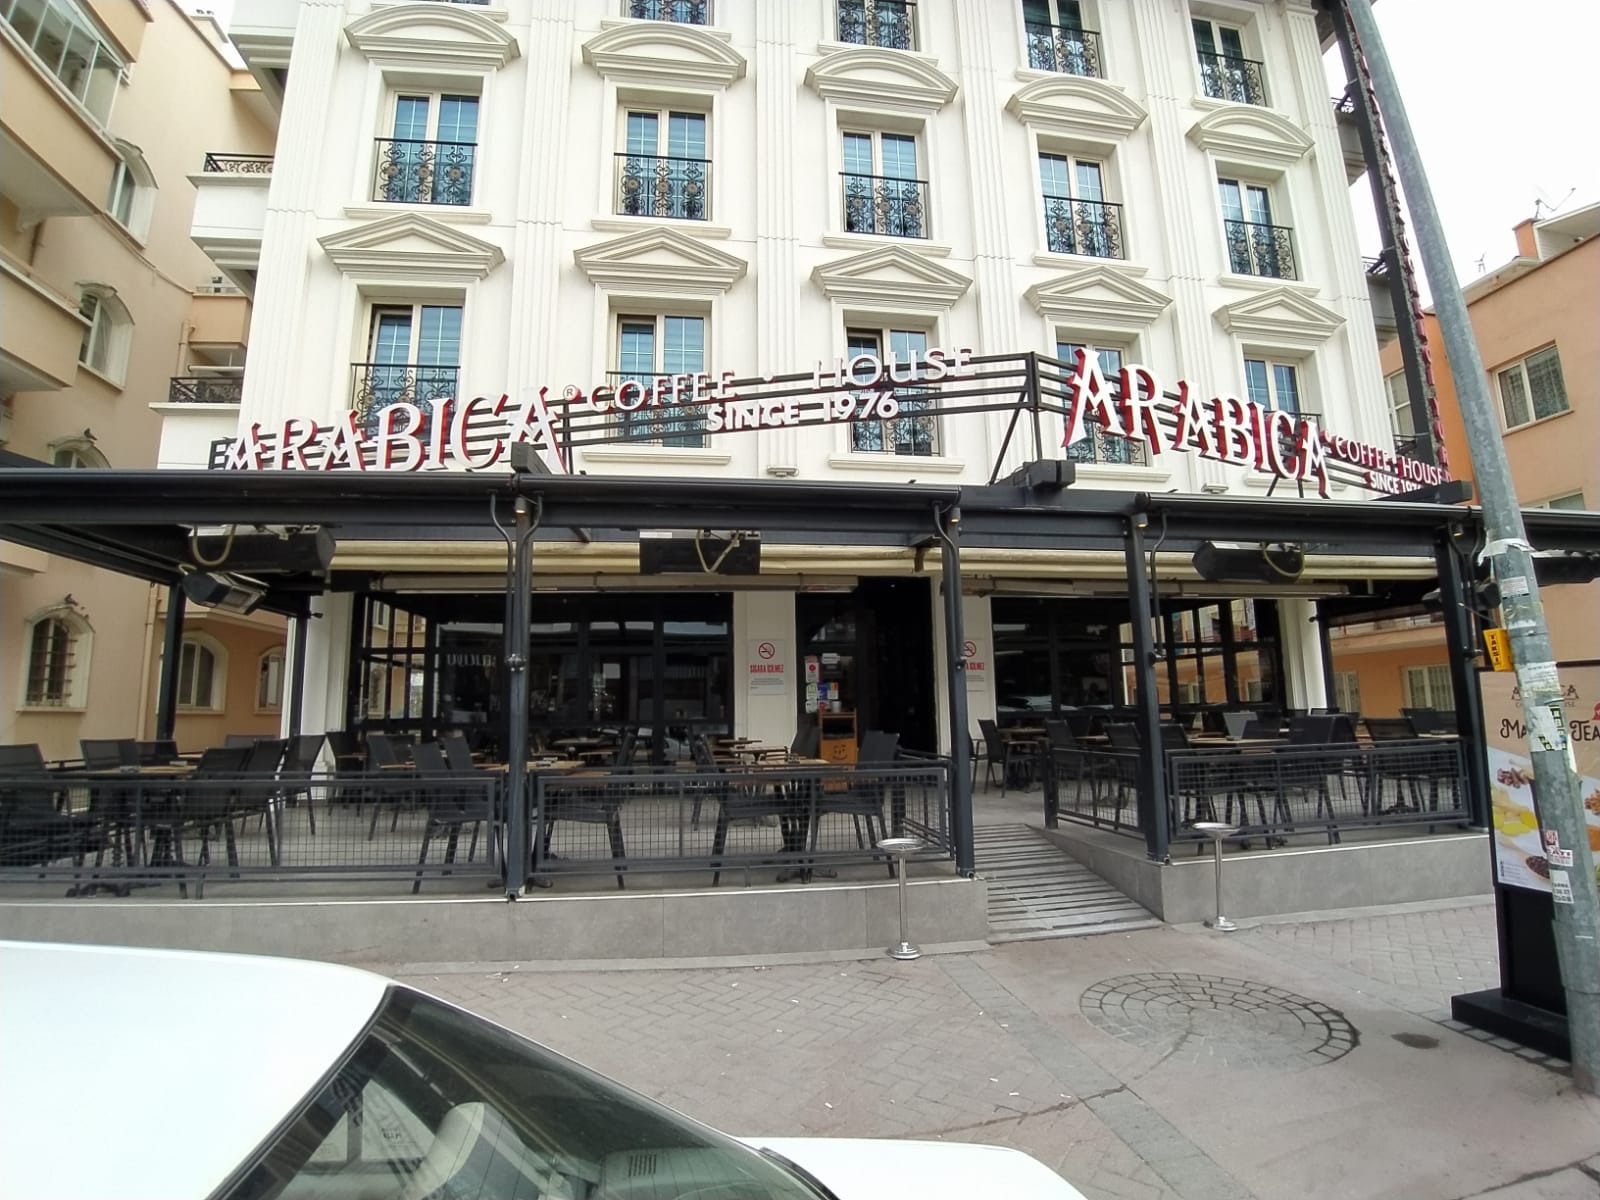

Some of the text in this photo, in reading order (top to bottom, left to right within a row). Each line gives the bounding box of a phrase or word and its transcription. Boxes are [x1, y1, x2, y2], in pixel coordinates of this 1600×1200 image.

[591, 346, 977, 413] COFFEE HOUSE
[225, 386, 567, 475] ARABICA
[707, 390, 900, 433] SINCE 1976
[1061, 346, 1331, 500] ARABICA
[1334, 435, 1391, 472] COFFEE
[1369, 470, 1400, 494] SINCE
